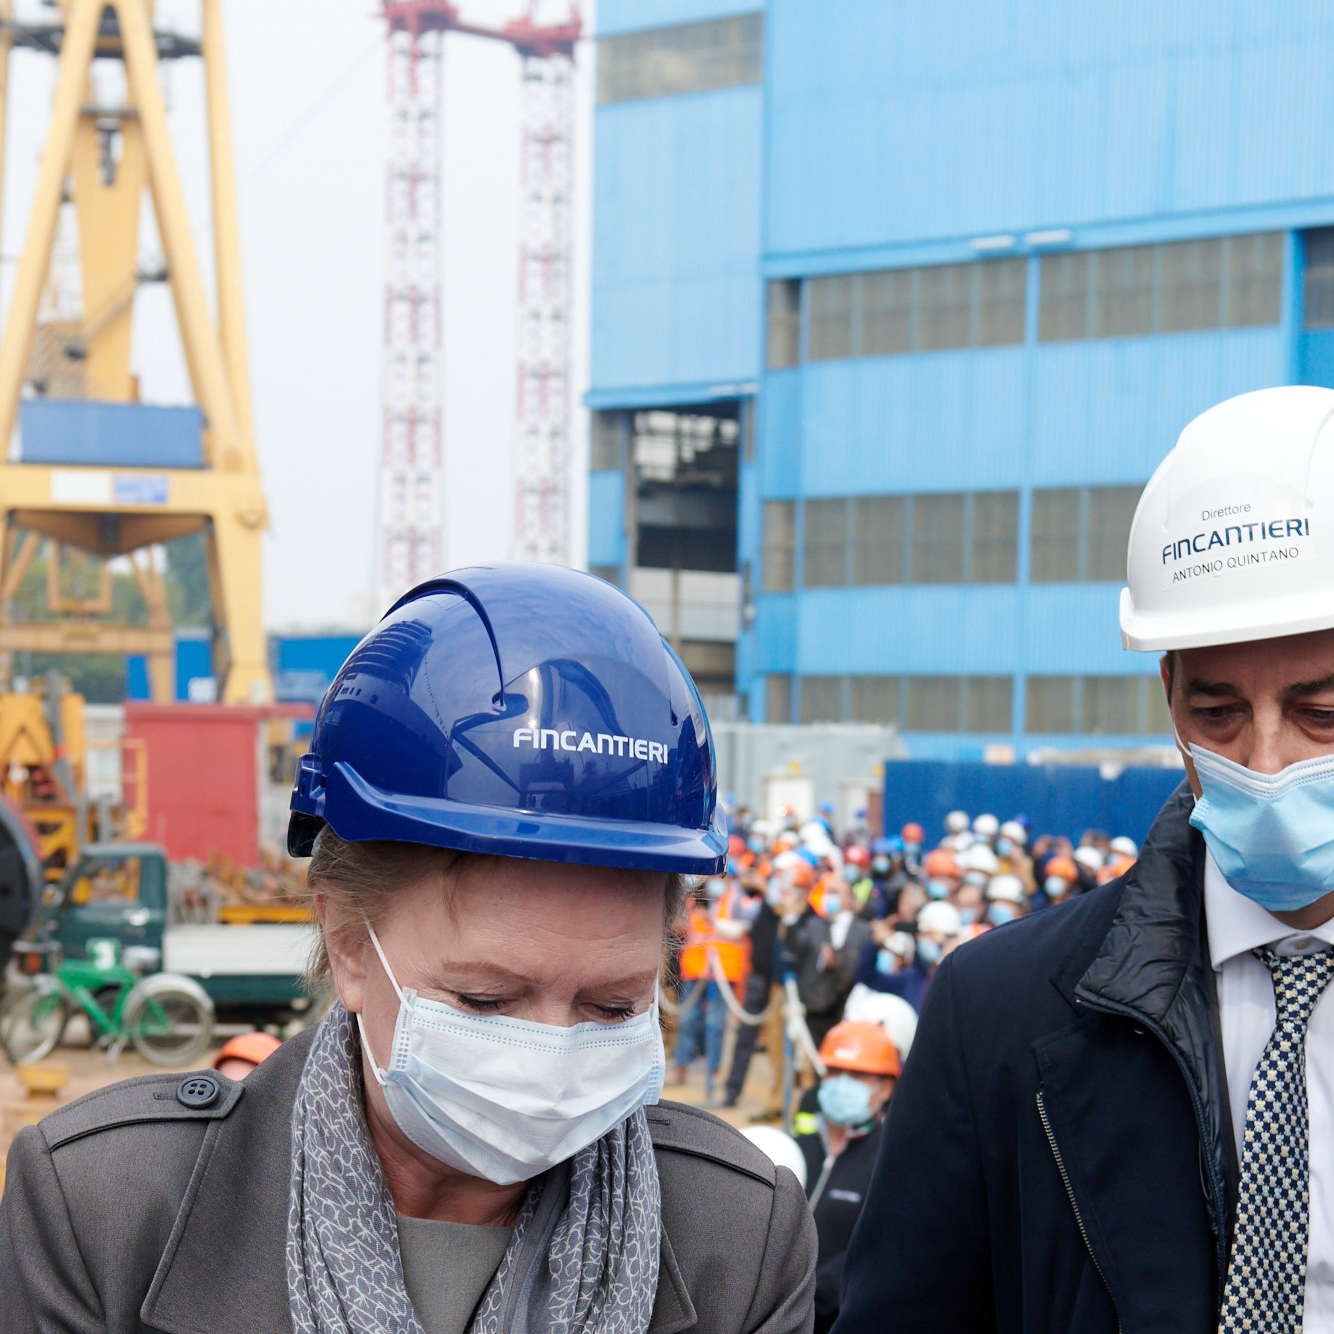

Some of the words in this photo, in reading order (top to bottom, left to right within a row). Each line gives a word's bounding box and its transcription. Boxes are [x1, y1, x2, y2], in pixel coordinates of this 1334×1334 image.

[1201, 503, 1252, 522] Direttore
[1162, 517, 1310, 565] FINCANTIERI
[1172, 559, 1224, 583] ANTONIO
[1226, 546, 1300, 569] QUINTANO
[512, 727, 669, 765] FINCANTIERI
